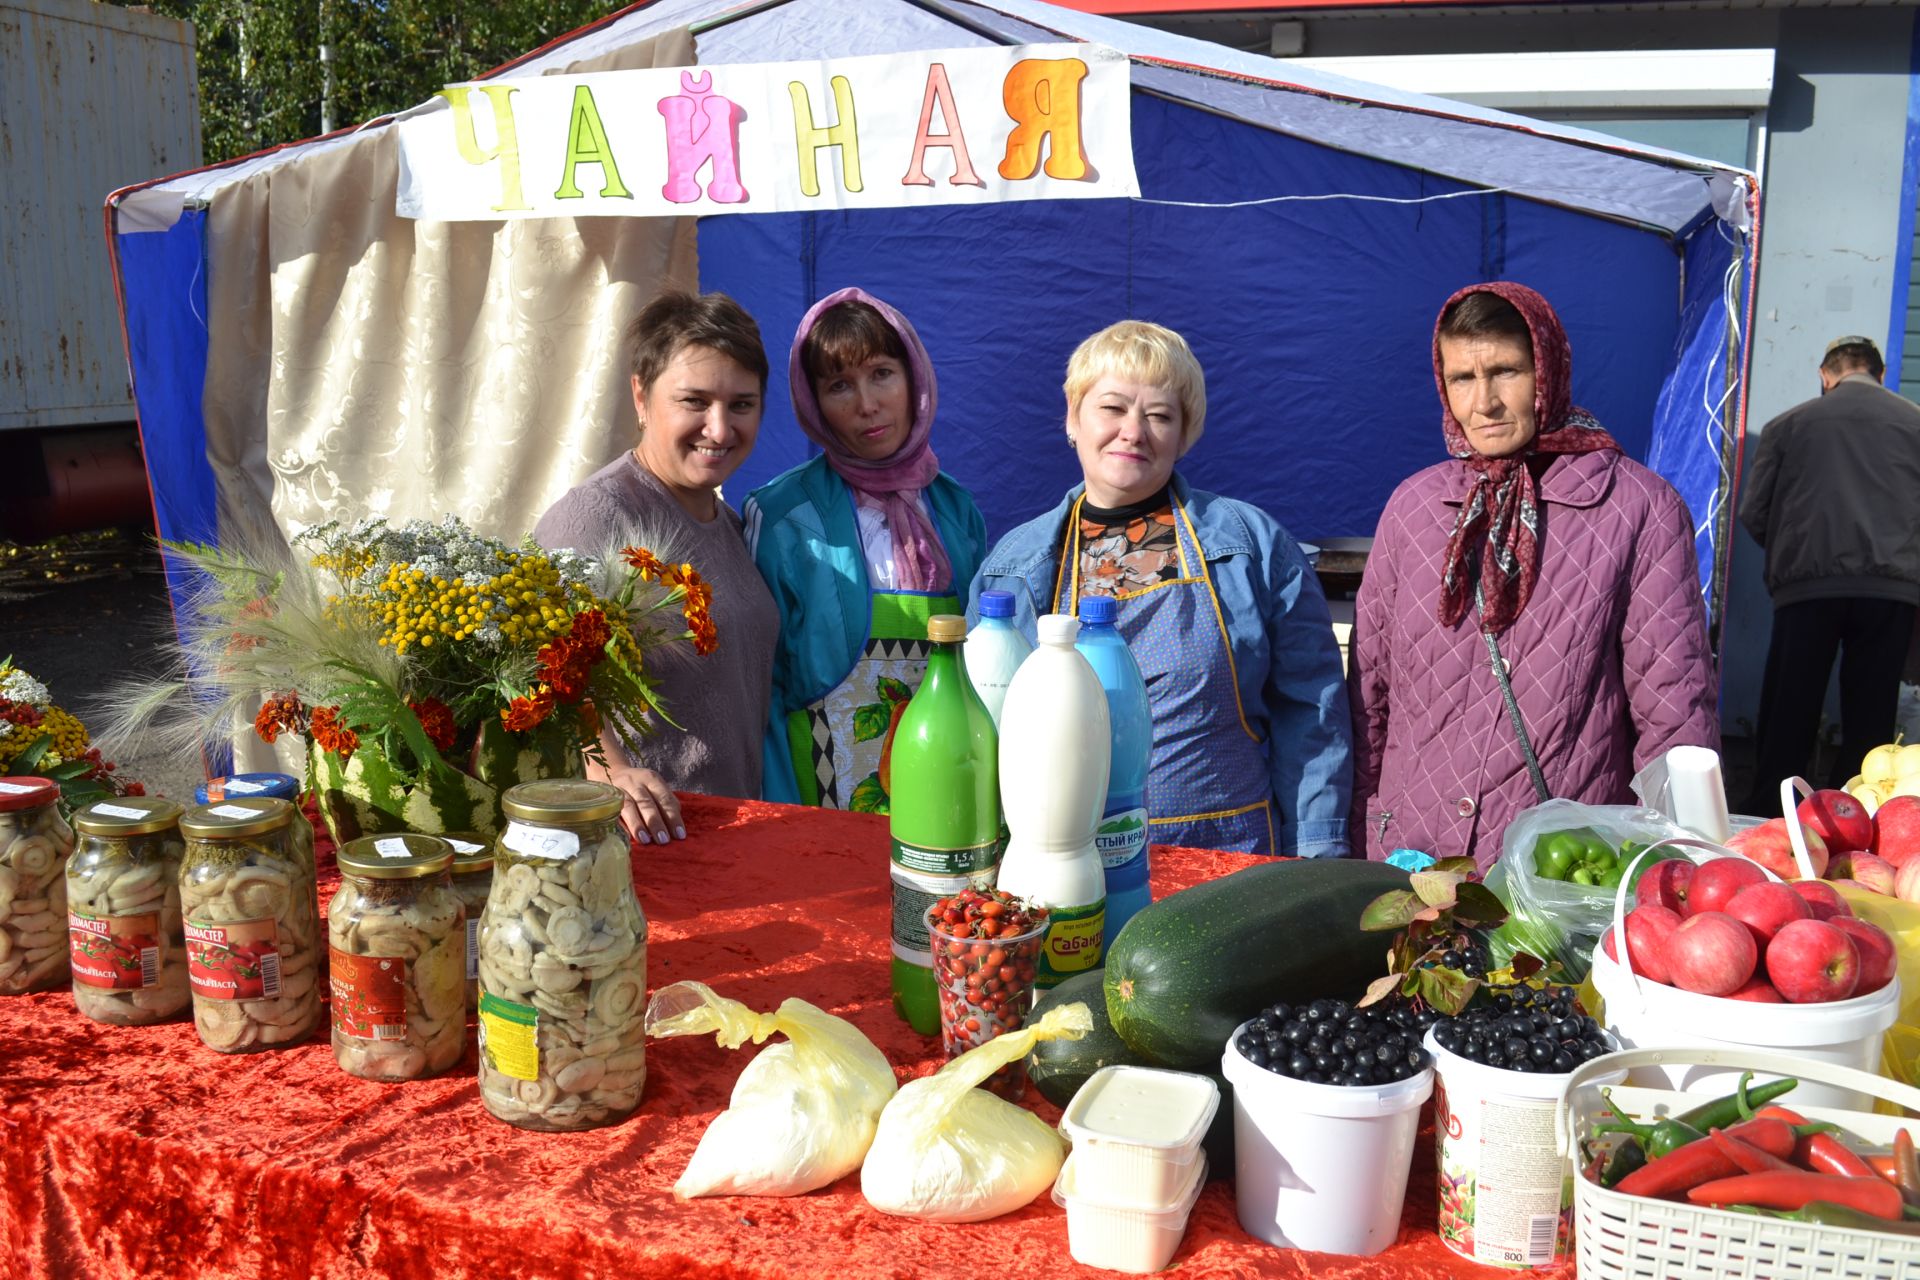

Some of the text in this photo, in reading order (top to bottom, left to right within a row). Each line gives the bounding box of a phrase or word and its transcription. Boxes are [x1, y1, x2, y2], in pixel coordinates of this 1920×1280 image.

[438, 57, 1089, 211] ЧАЙНАЯ
[1094, 834, 1126, 848] СТЫЙ
[1052, 929, 1104, 956] Сабанту
[1504, 1251, 1523, 1263] 800
